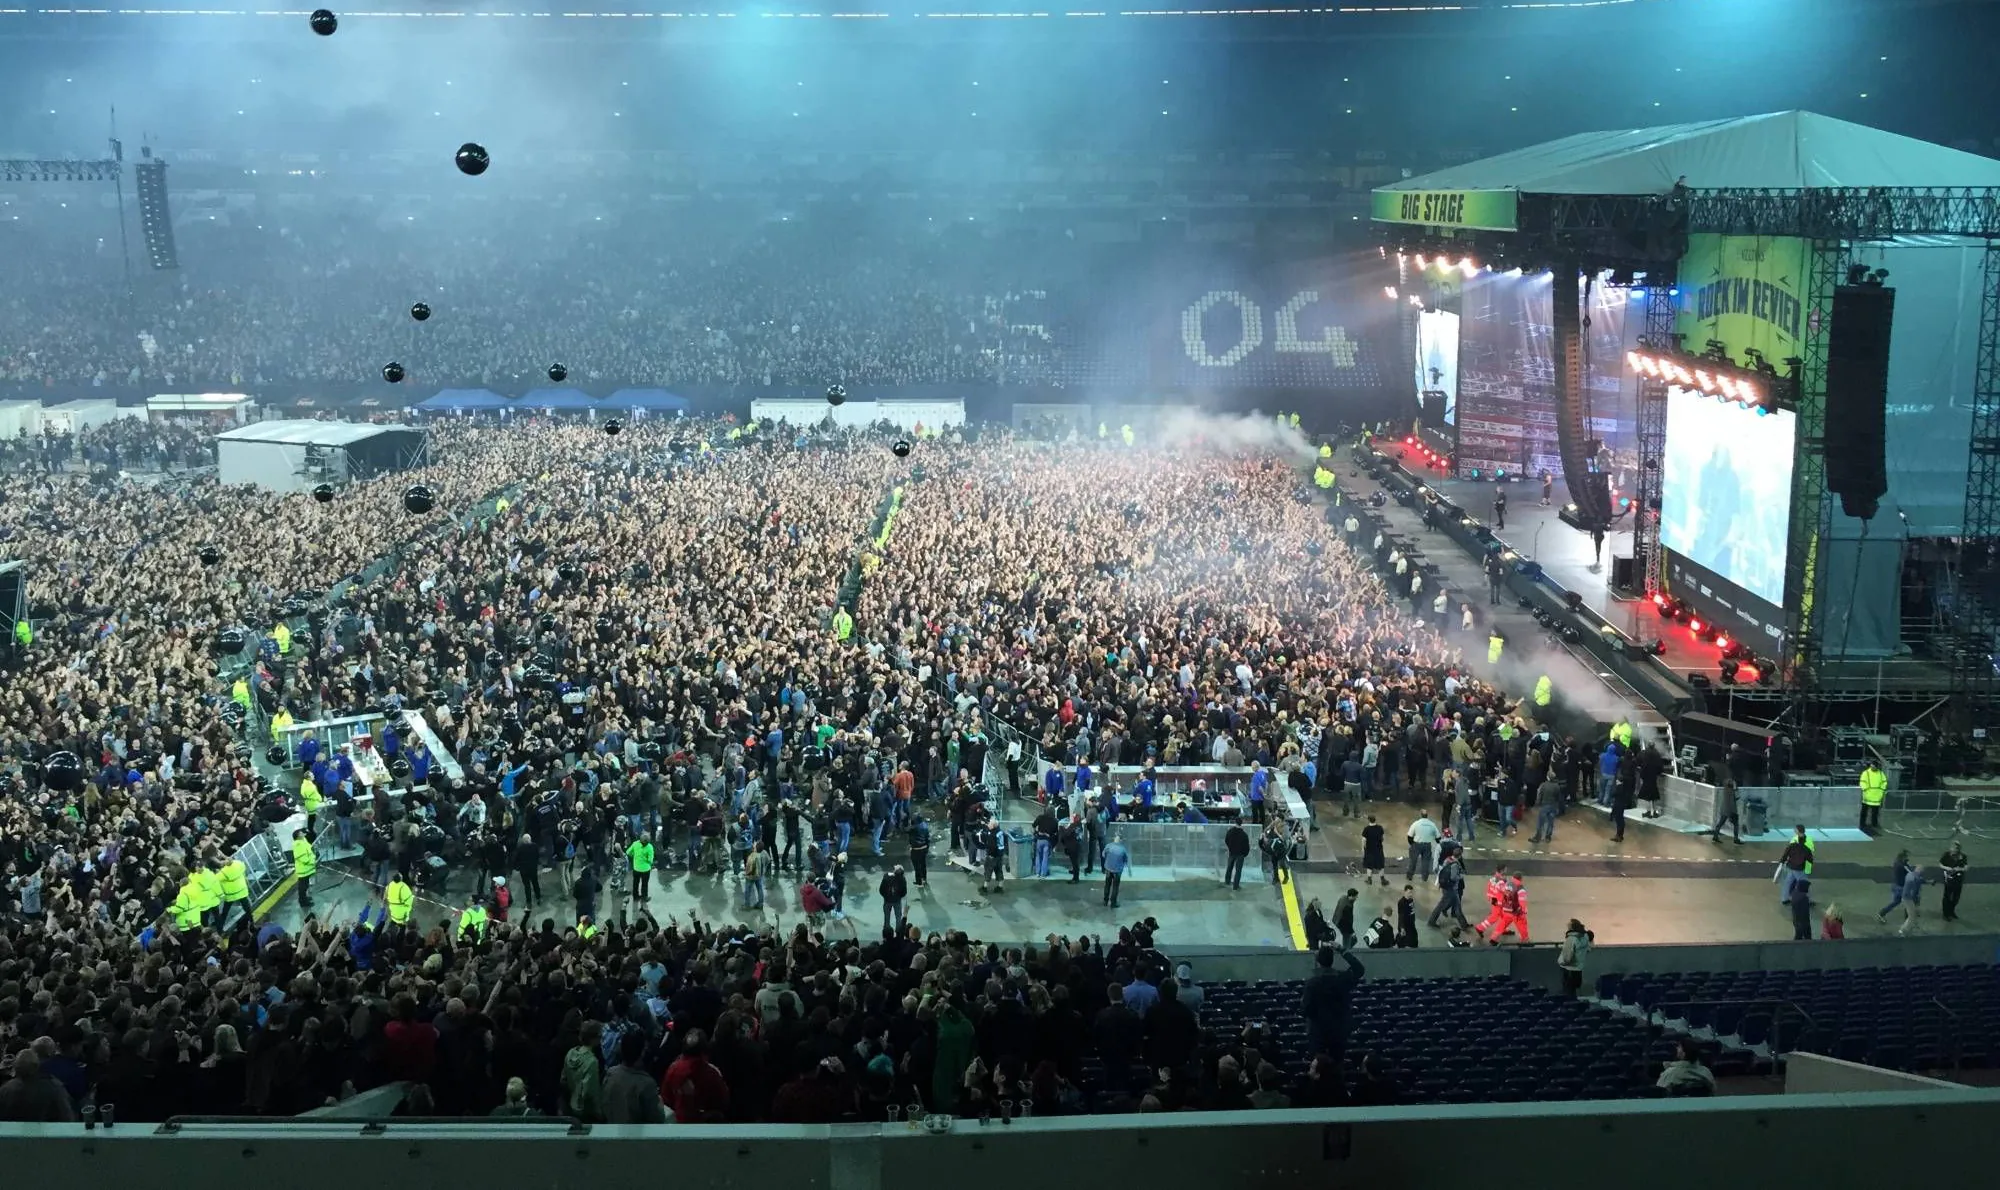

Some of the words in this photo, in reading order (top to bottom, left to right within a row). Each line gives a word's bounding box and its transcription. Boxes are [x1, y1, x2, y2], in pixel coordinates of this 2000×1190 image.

[1401, 193, 1421, 220] BIG
[1424, 193, 1465, 223] STAGE
[1182, 290, 1358, 369] 04
[1697, 278, 1731, 323] ROCK
[1732, 276, 1750, 315] IM
[1752, 278, 1801, 342] REVIER
